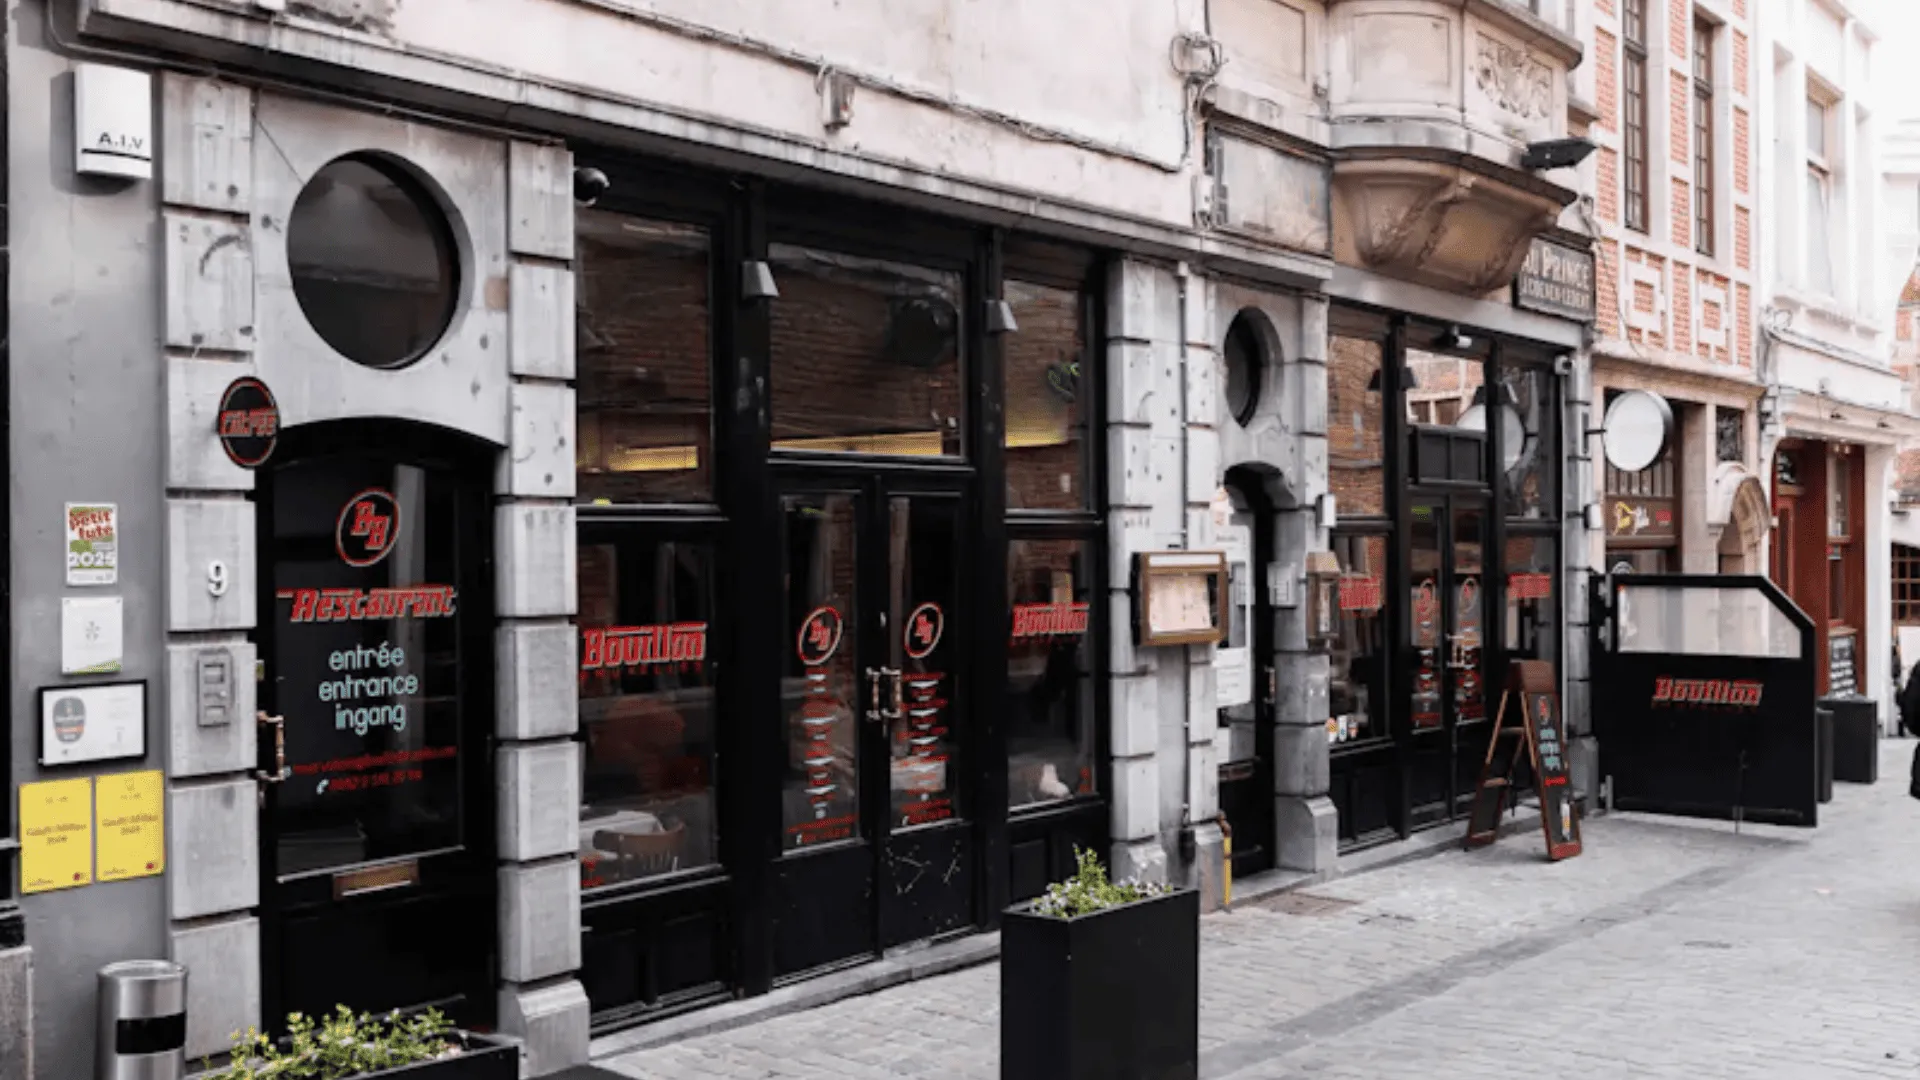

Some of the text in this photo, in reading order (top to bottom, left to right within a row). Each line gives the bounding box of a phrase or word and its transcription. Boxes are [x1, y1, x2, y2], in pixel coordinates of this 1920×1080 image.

[207, 559, 228, 597] 9
[276, 584, 457, 622] Restaurant
[328, 641, 405, 671] entrée
[581, 621, 707, 669] Bouillon
[318, 674, 418, 701] entrance
[335, 702, 406, 735] ingang
